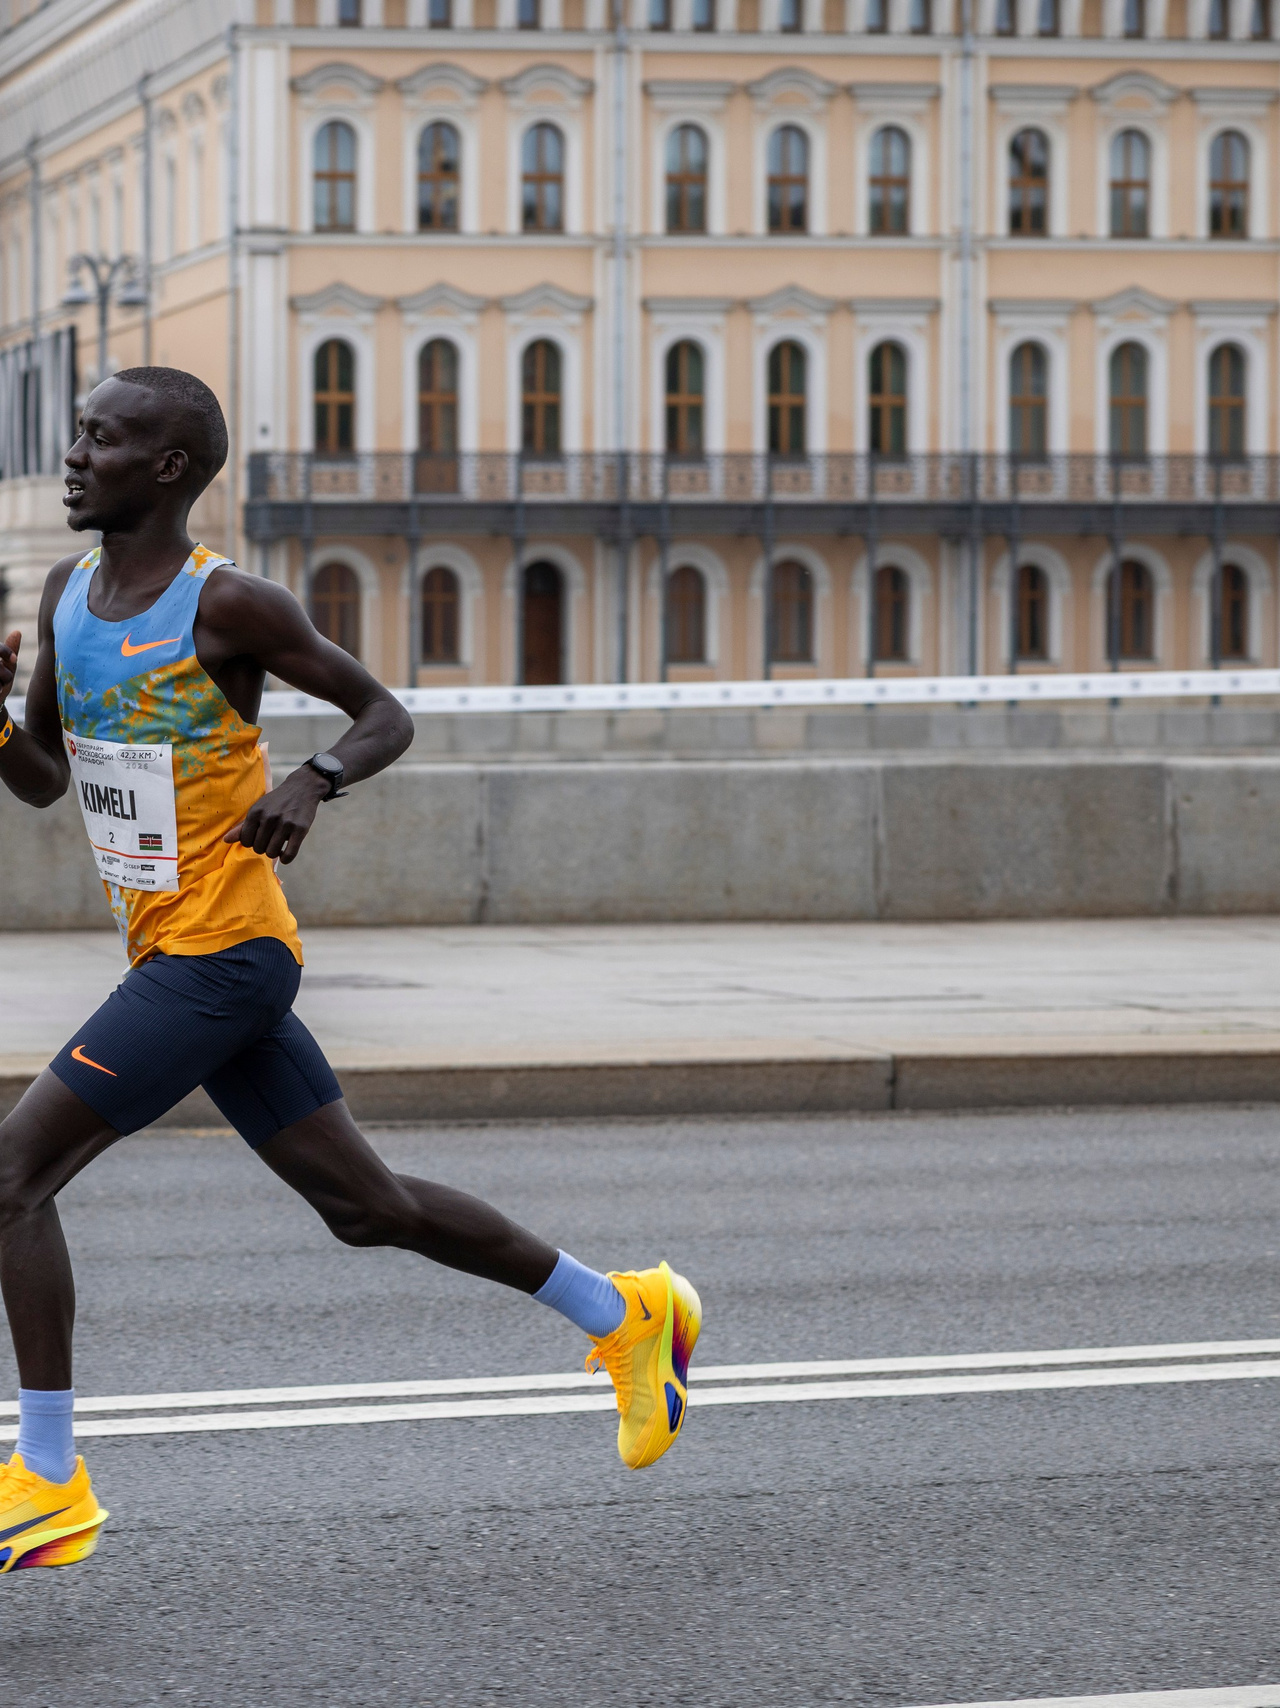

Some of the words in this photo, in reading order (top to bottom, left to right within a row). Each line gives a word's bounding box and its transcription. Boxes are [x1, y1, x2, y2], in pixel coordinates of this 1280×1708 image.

[77, 749, 114, 761] МОСКОВСКИЙ
[78, 755, 105, 766] МАРАФОН
[120, 751, 137, 760] 42,2
[80, 779, 137, 821] KIMELI
[108, 831, 115, 844] 2
